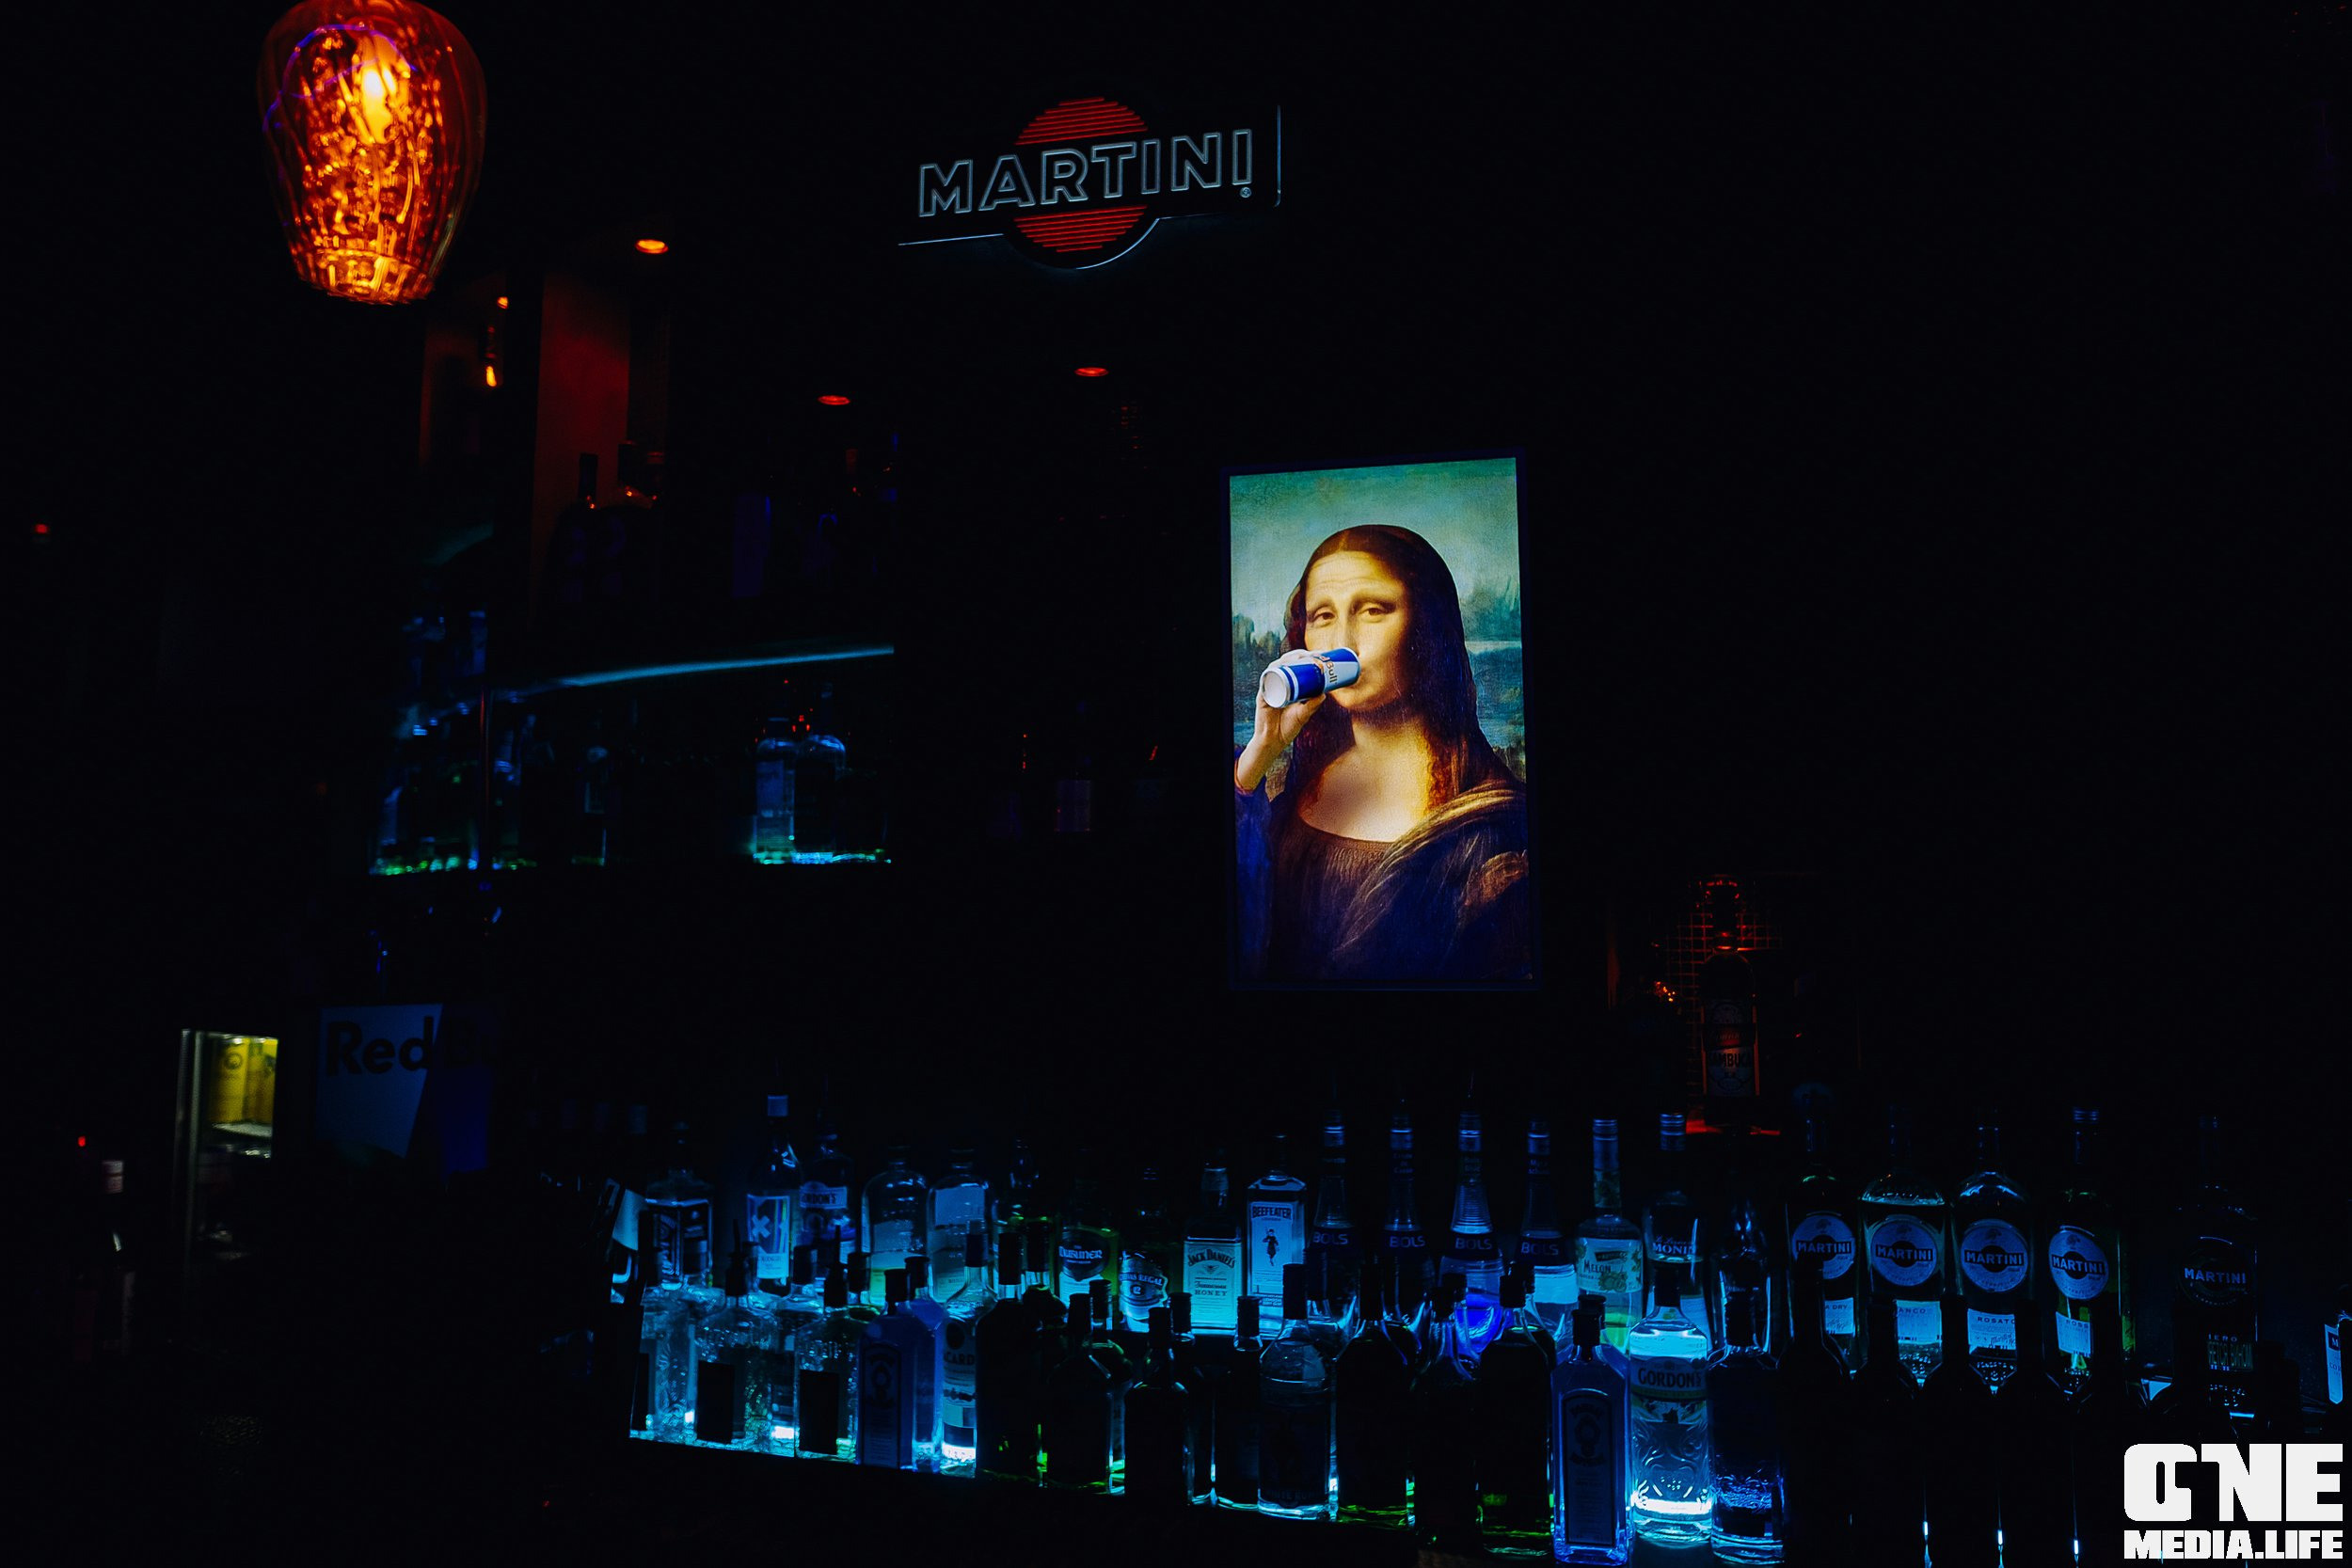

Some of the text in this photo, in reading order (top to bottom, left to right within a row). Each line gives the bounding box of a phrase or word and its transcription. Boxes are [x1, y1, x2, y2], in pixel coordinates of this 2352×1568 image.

[918, 128, 1253, 217] MARTINI
[327, 1016, 433, 1074] Red
[1252, 1205, 1292, 1220] BEEFEATER
[1312, 1231, 1349, 1246] BOLS
[1389, 1235, 1426, 1249] BOLS
[1454, 1237, 1492, 1252] BOLS
[1520, 1242, 1559, 1257] BOLS
[1798, 1241, 1851, 1255] MARTINI
[1877, 1245, 1931, 1261] MARTINI
[1188, 1252, 1206, 1268] JACK
[1966, 1251, 2023, 1266] MARTINI
[2053, 1256, 2104, 1274] MARTINI
[2184, 1267, 2247, 1285] MARTINI
[2065, 1319, 2090, 1330] ROSS
[1638, 1367, 1703, 1389] GORDON'S
